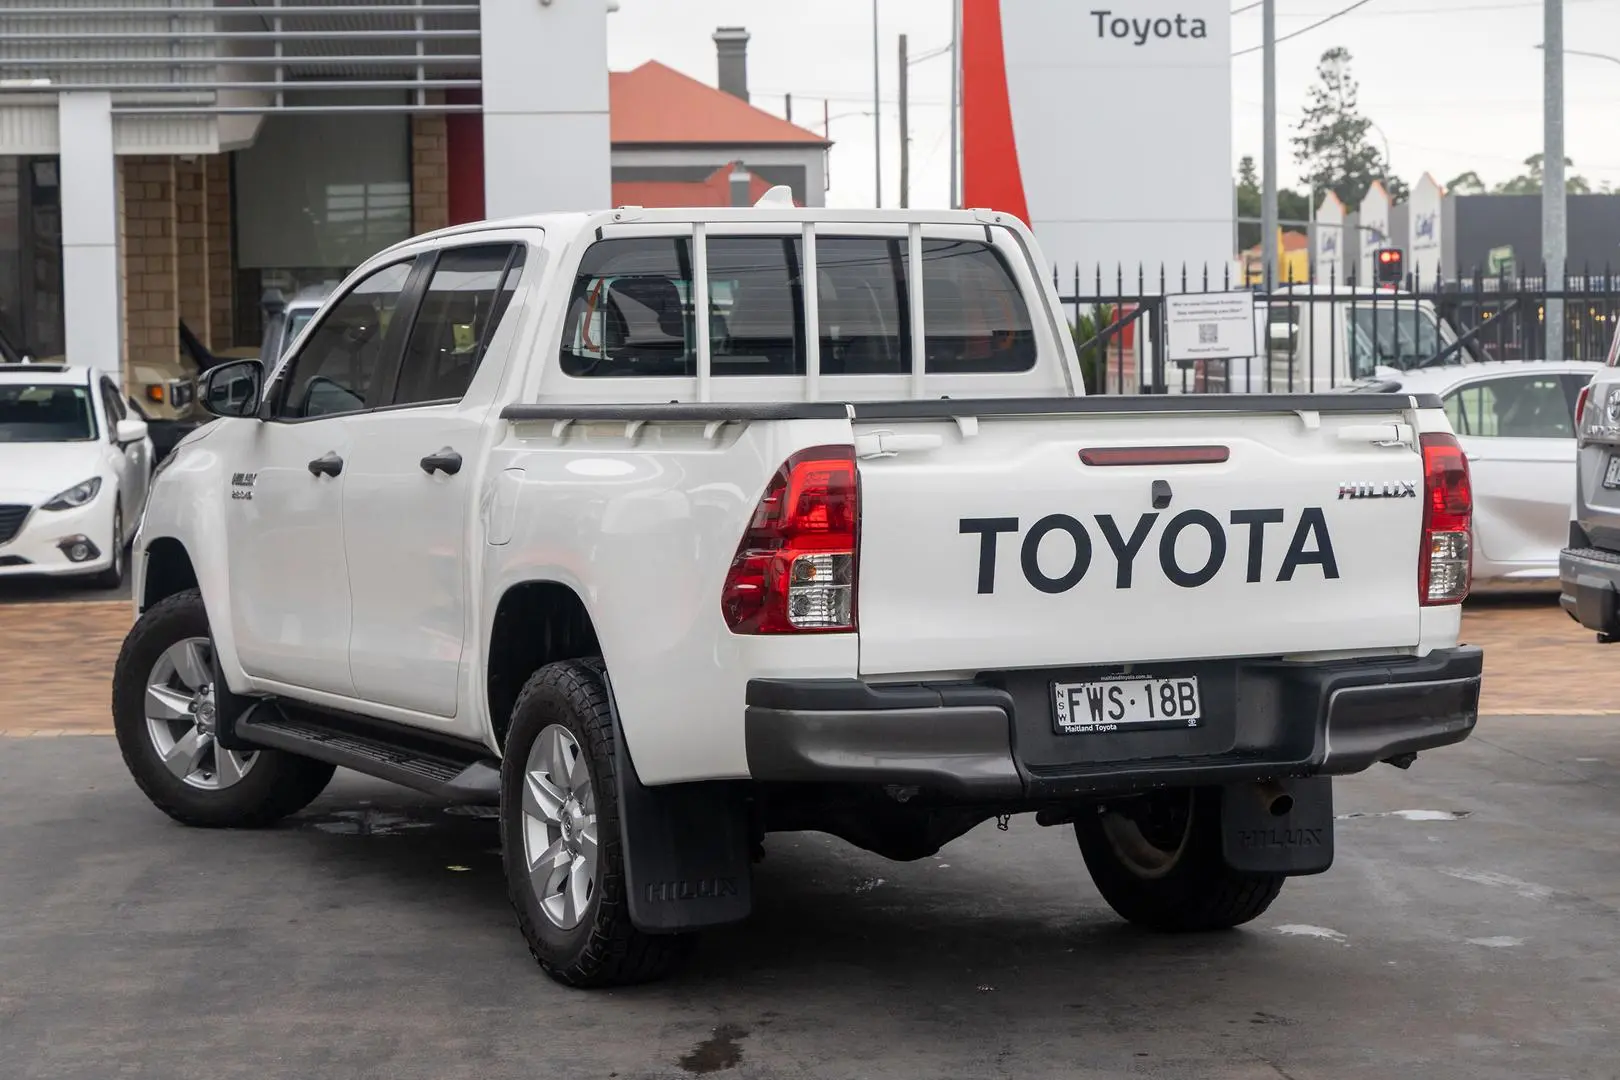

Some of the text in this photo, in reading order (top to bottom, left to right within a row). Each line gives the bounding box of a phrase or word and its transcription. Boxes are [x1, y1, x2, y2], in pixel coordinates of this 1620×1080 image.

[1090, 10, 1207, 46] Toyota
[1337, 479, 1418, 500] HILUX
[959, 507, 1340, 594] TOYOTA
[1065, 723, 1118, 733] Maitland Toyota
[1238, 828, 1323, 847] HILUX
[643, 877, 738, 904] HILUX
